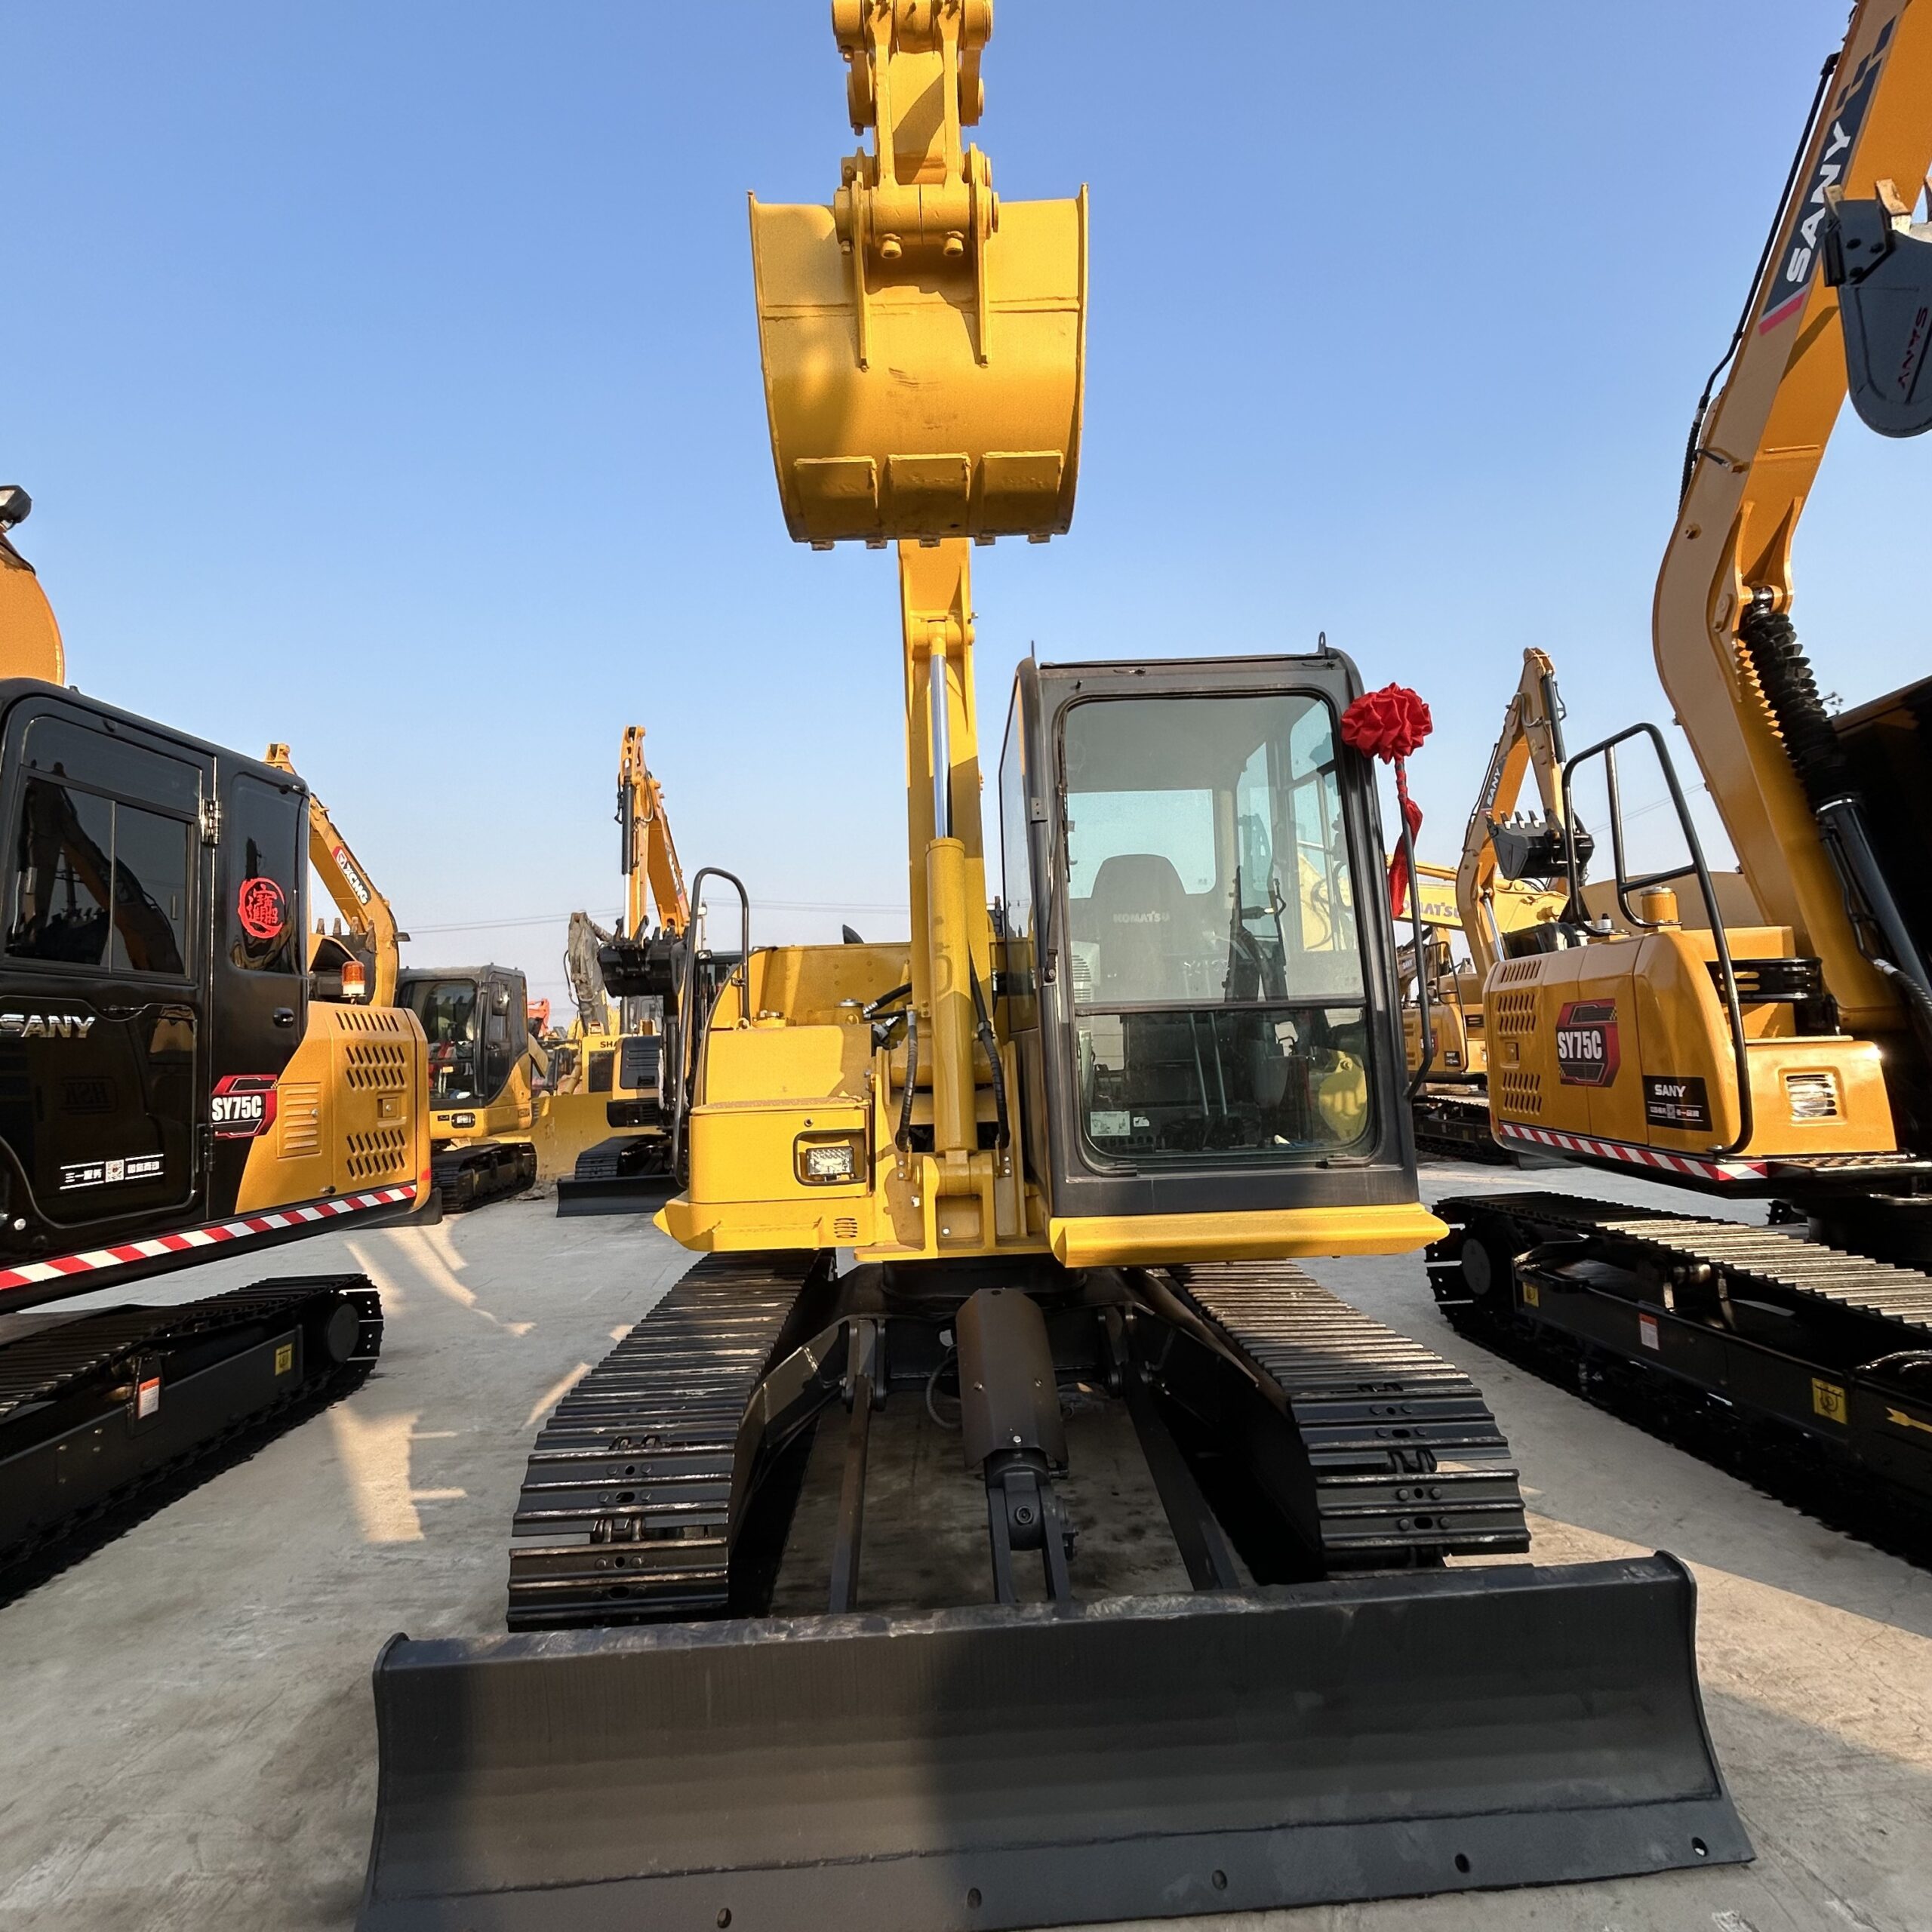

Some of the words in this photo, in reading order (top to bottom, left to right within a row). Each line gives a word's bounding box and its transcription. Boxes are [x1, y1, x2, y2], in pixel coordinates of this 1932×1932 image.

[1786, 121, 1850, 282] SANY
[1487, 767, 1501, 806] SANY
[343, 863, 368, 904] XCMG
[1113, 910, 1171, 922] KOMATSU
[0, 1014, 96, 1038] SANY
[1557, 1030, 1602, 1060] SY75C
[1654, 1084, 1687, 1097] SANY
[212, 1095, 262, 1121] SY75C
